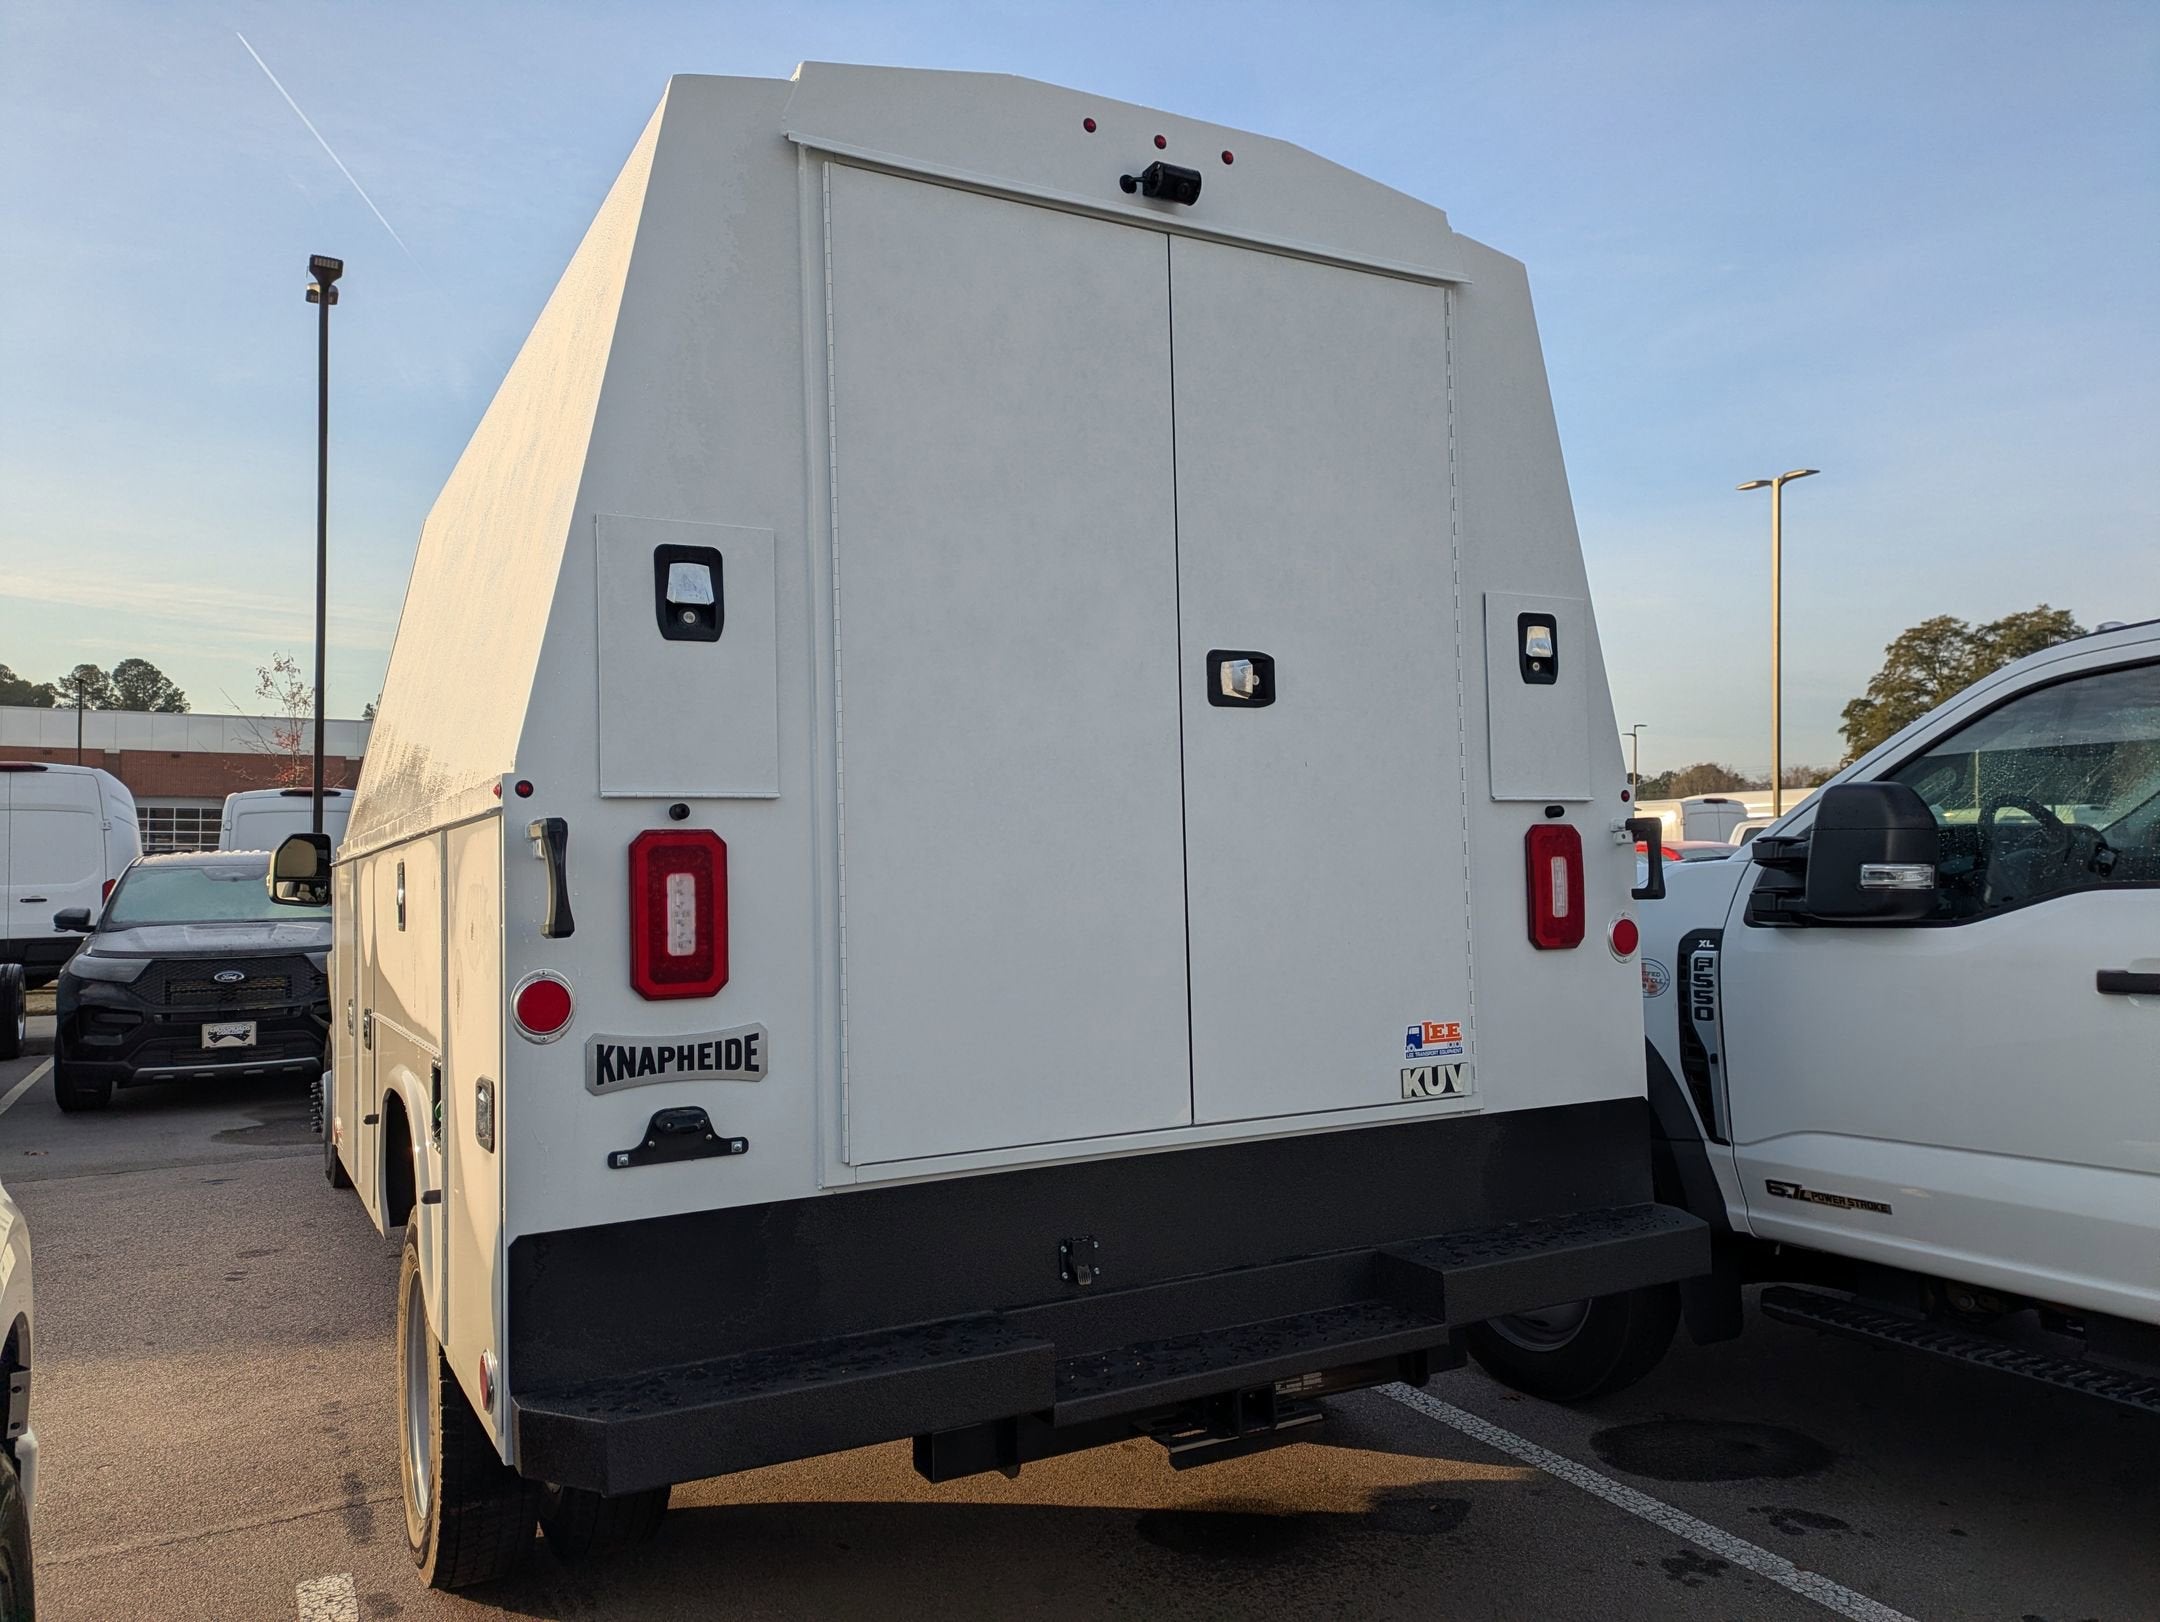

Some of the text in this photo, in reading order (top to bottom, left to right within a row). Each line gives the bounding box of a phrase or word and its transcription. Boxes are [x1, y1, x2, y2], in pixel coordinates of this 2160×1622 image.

[1698, 939, 1715, 948] XL
[1422, 1021, 1462, 1044] LEE
[596, 1032, 760, 1086] KNAPHEIDE
[1401, 1062, 1469, 1099] KUV
[1811, 1191, 1845, 1206] POWER
[1846, 1198, 1890, 1213] STROKE
